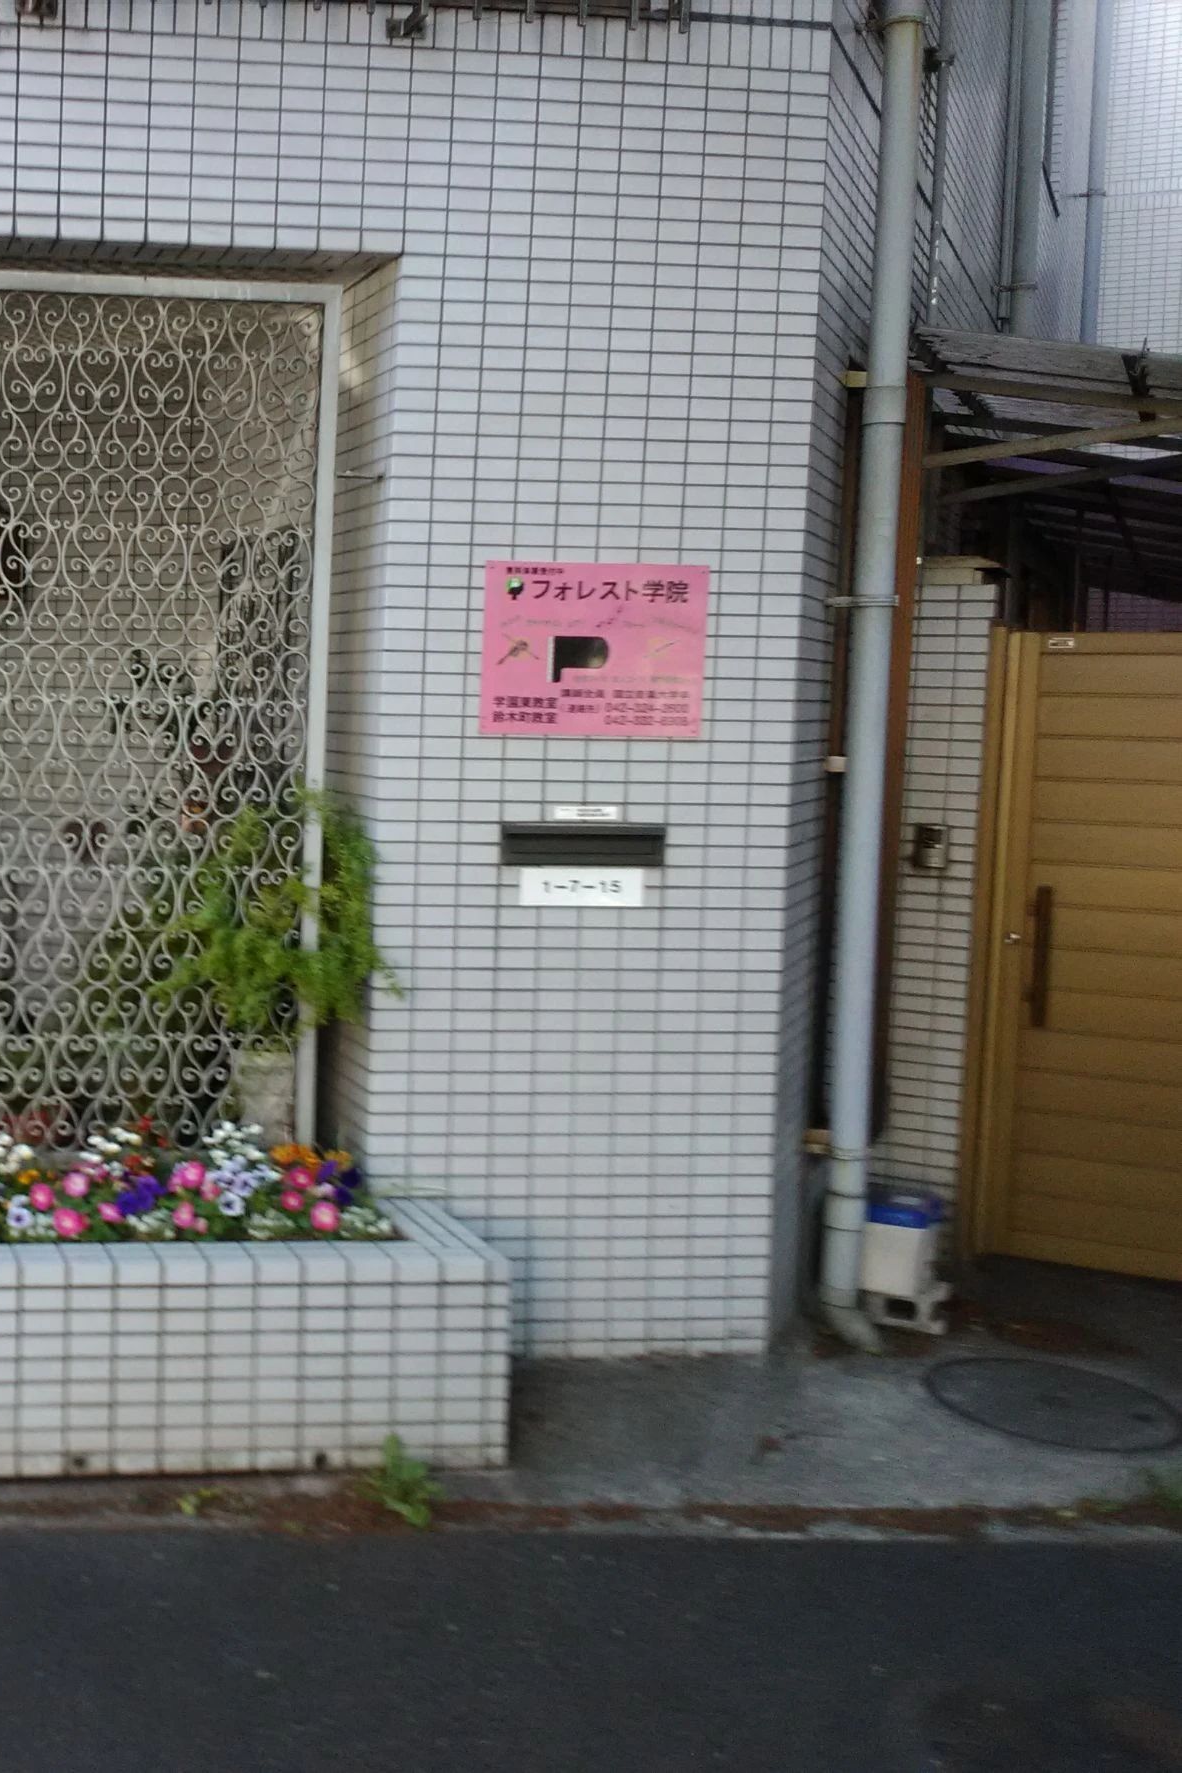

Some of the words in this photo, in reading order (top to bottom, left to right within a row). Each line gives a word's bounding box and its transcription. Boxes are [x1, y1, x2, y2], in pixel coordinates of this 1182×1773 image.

[532, 580, 689, 603] フォレスト学院
[542, 879, 622, 893] 1-7-15
